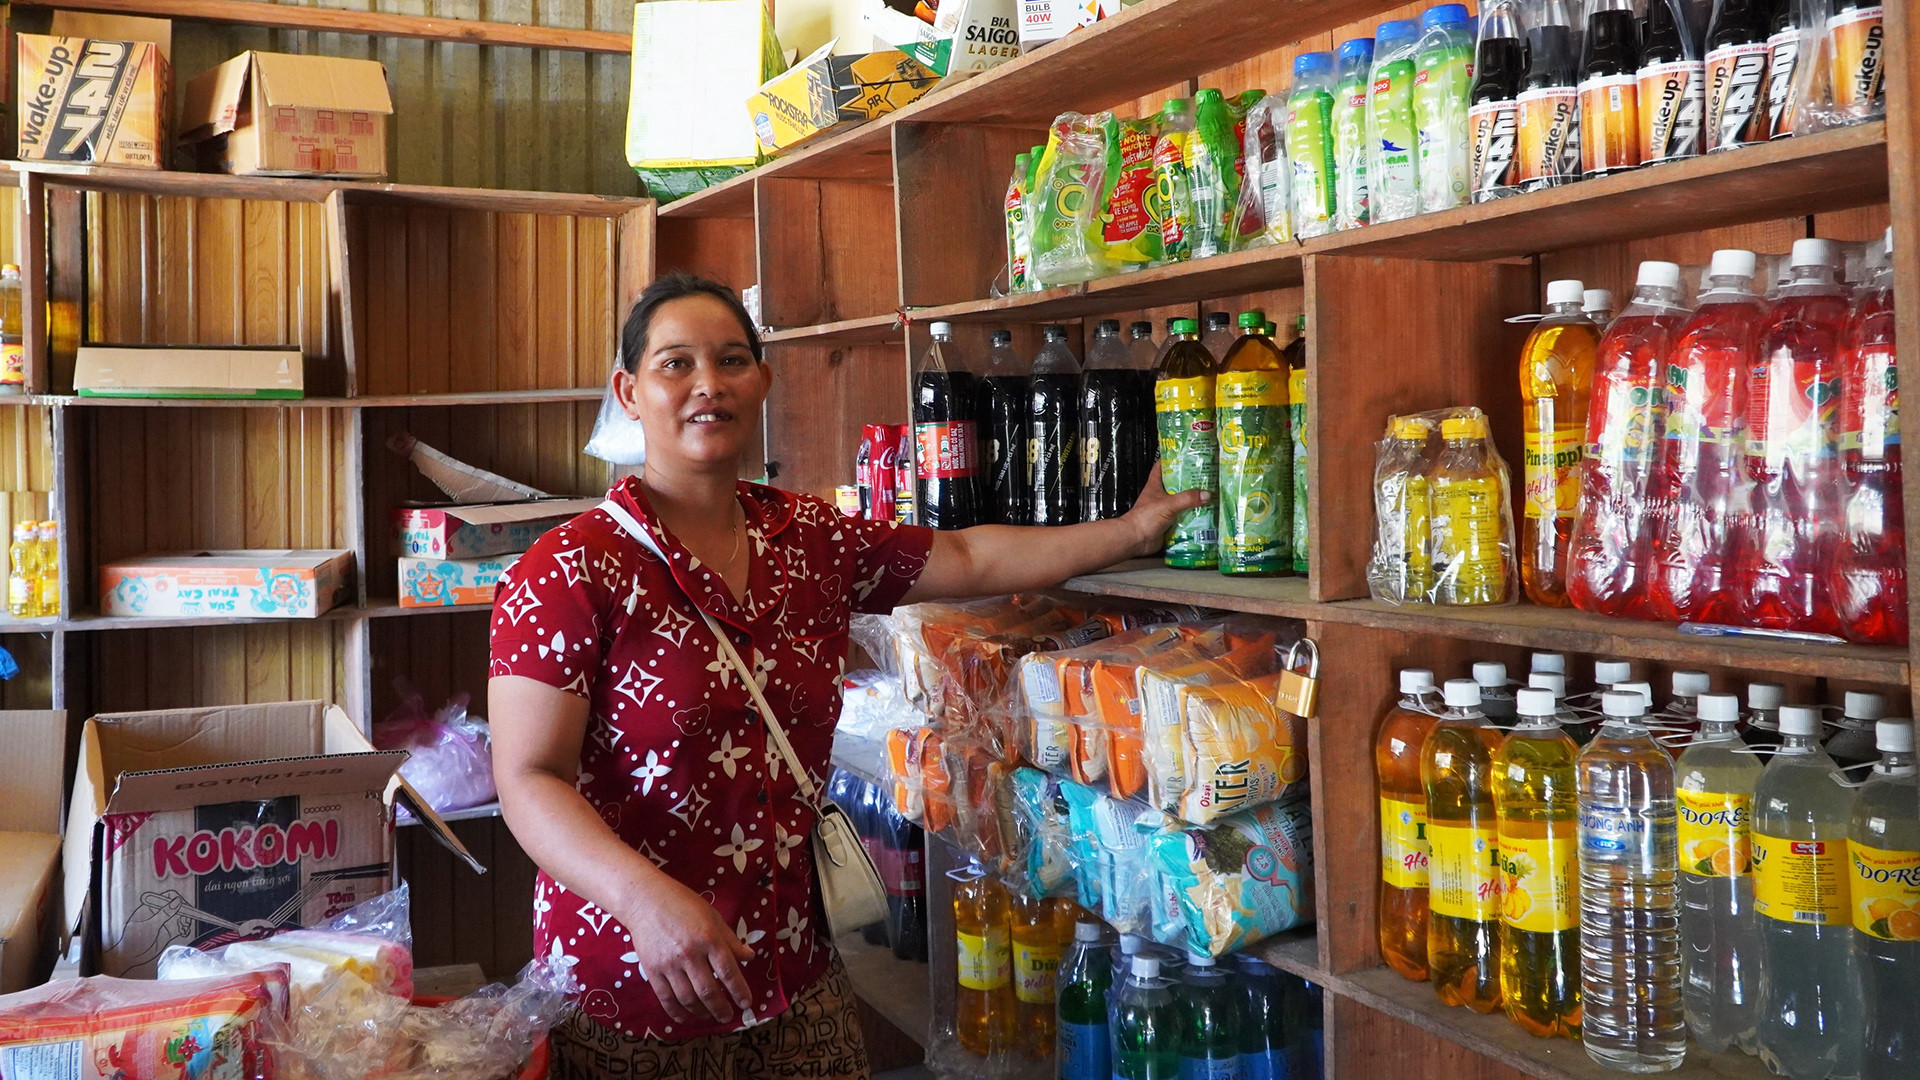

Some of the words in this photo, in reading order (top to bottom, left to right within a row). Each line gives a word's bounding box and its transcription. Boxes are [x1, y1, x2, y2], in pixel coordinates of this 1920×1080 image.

[1025, 3, 1051, 13] BULB
[991, 16, 1010, 28] BIA
[1026, 13, 1052, 24] 40W
[965, 25, 1019, 46] SAIGO
[968, 43, 1019, 58] LAGER
[151, 818, 340, 881] KOKOMI
